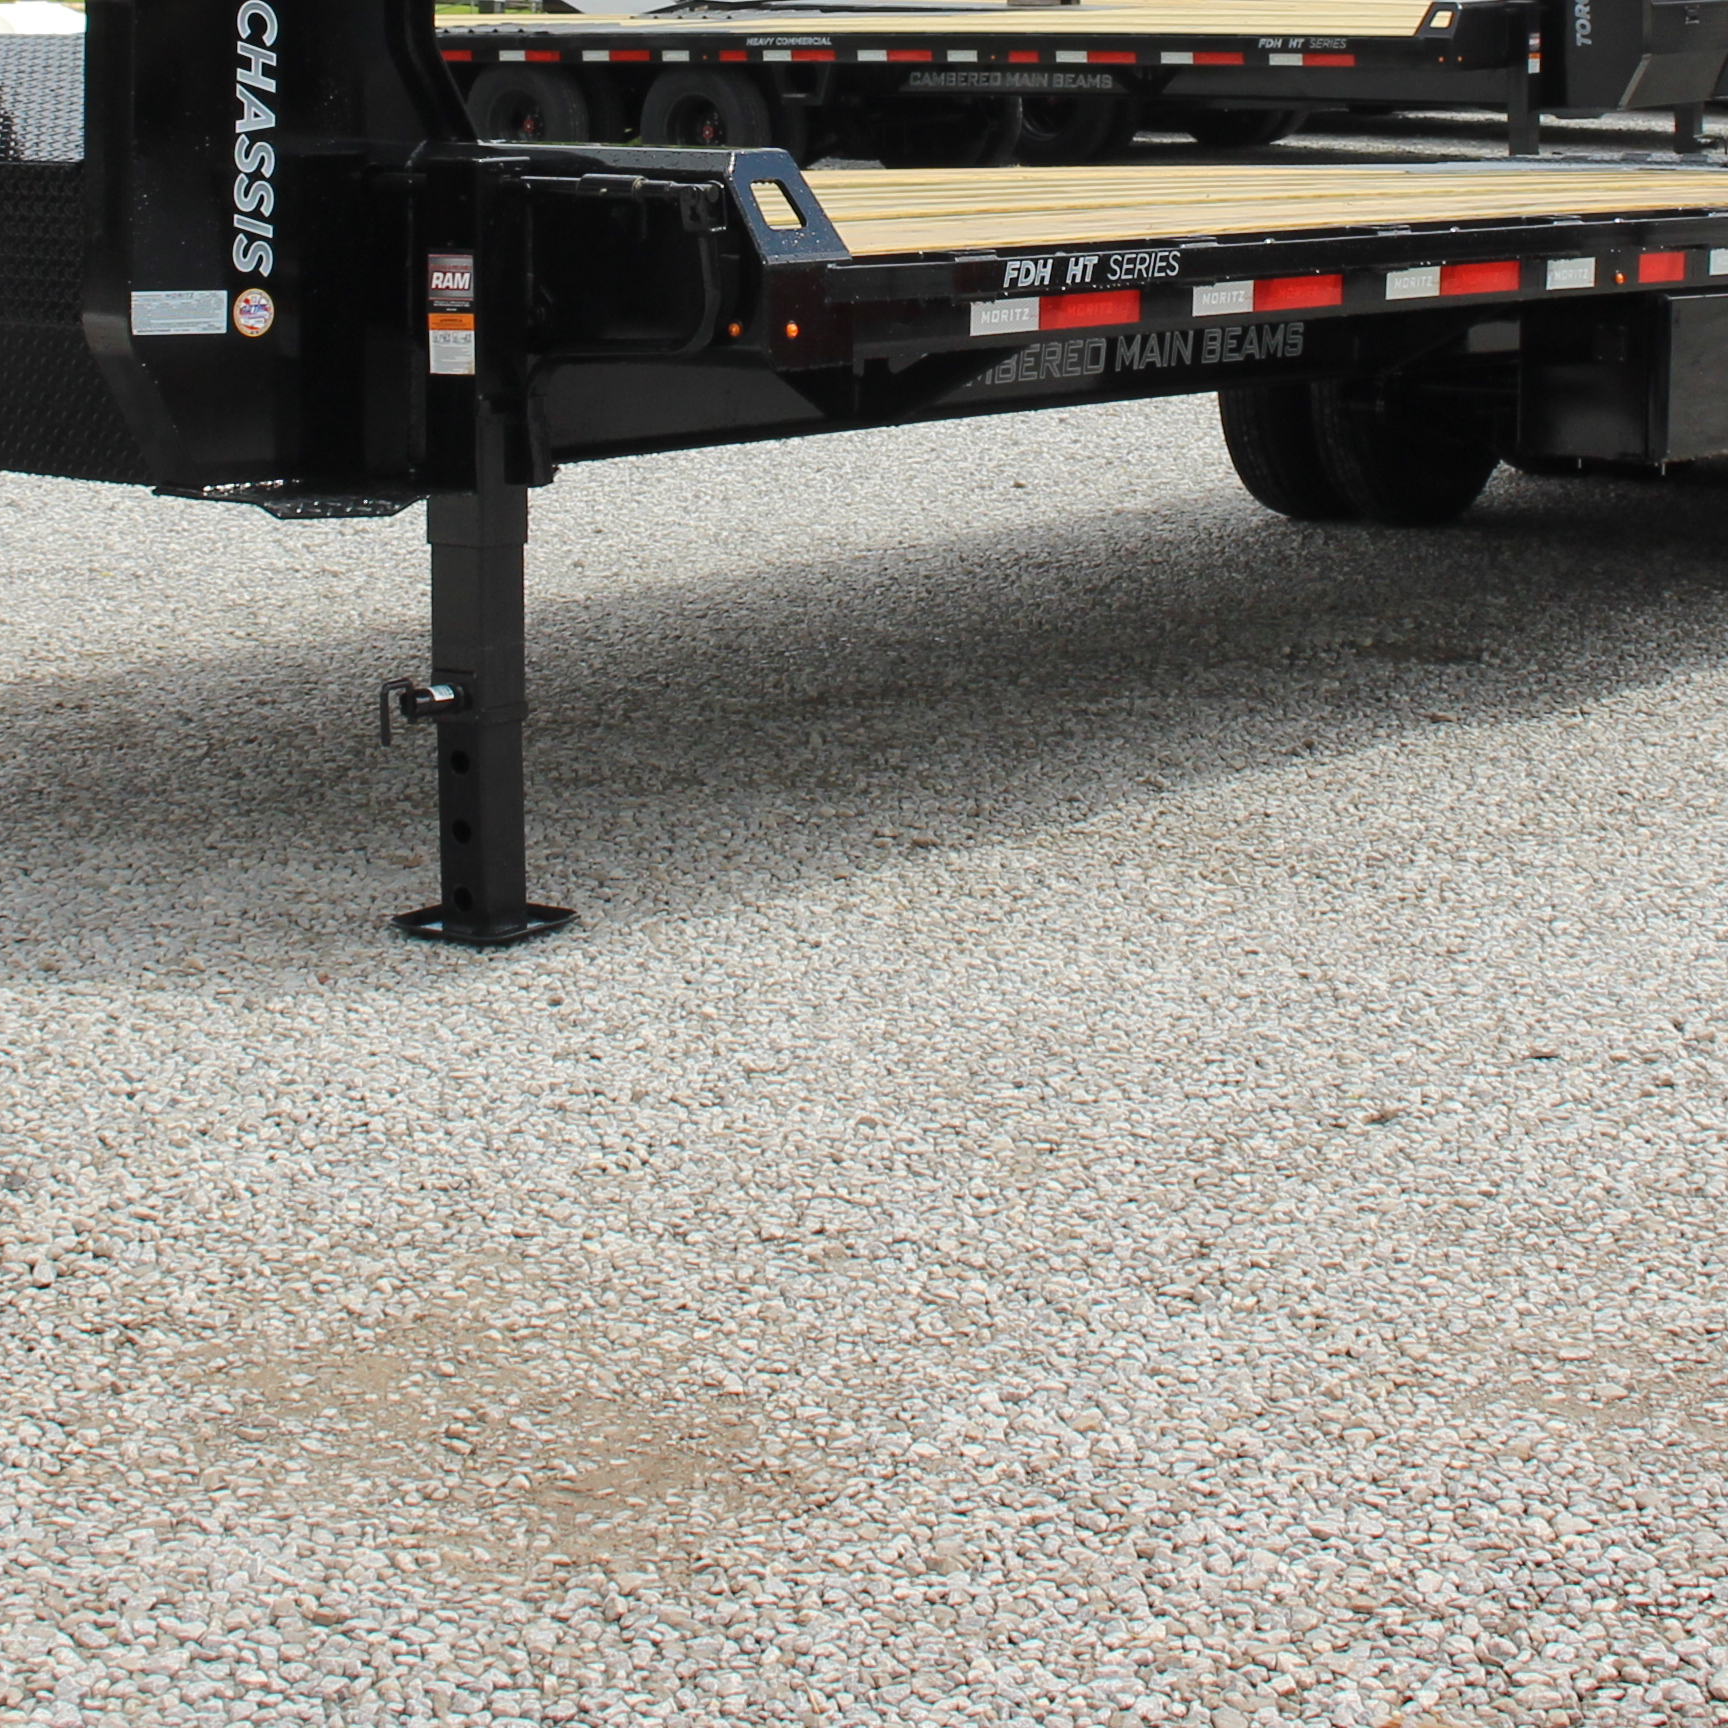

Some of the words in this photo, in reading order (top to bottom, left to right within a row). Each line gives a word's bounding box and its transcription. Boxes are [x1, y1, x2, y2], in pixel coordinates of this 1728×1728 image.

[746, 36, 775, 47] HEAVY
[775, 36, 832, 46] COMMERCIAL
[1258, 38, 1283, 49] FDH
[1288, 38, 1306, 49] HT
[1309, 38, 1347, 49] SERIES
[908, 71, 1002, 88] CAMBERED
[1007, 72, 1049, 89] MAIN
[1052, 73, 1114, 89] BEAMS
[1003, 258, 1054, 289] FDH
[1065, 256, 1100, 286] HT
[1107, 251, 1182, 281] SERIES
[431, 271, 471, 291] RAM
[1393, 275, 1434, 290] MORITZ
[1201, 290, 1246, 307] MORITZ
[980, 306, 1031, 325] MORITZ
[1115, 329, 1195, 372] MAIN
[1201, 322, 1305, 365] BEAMS
